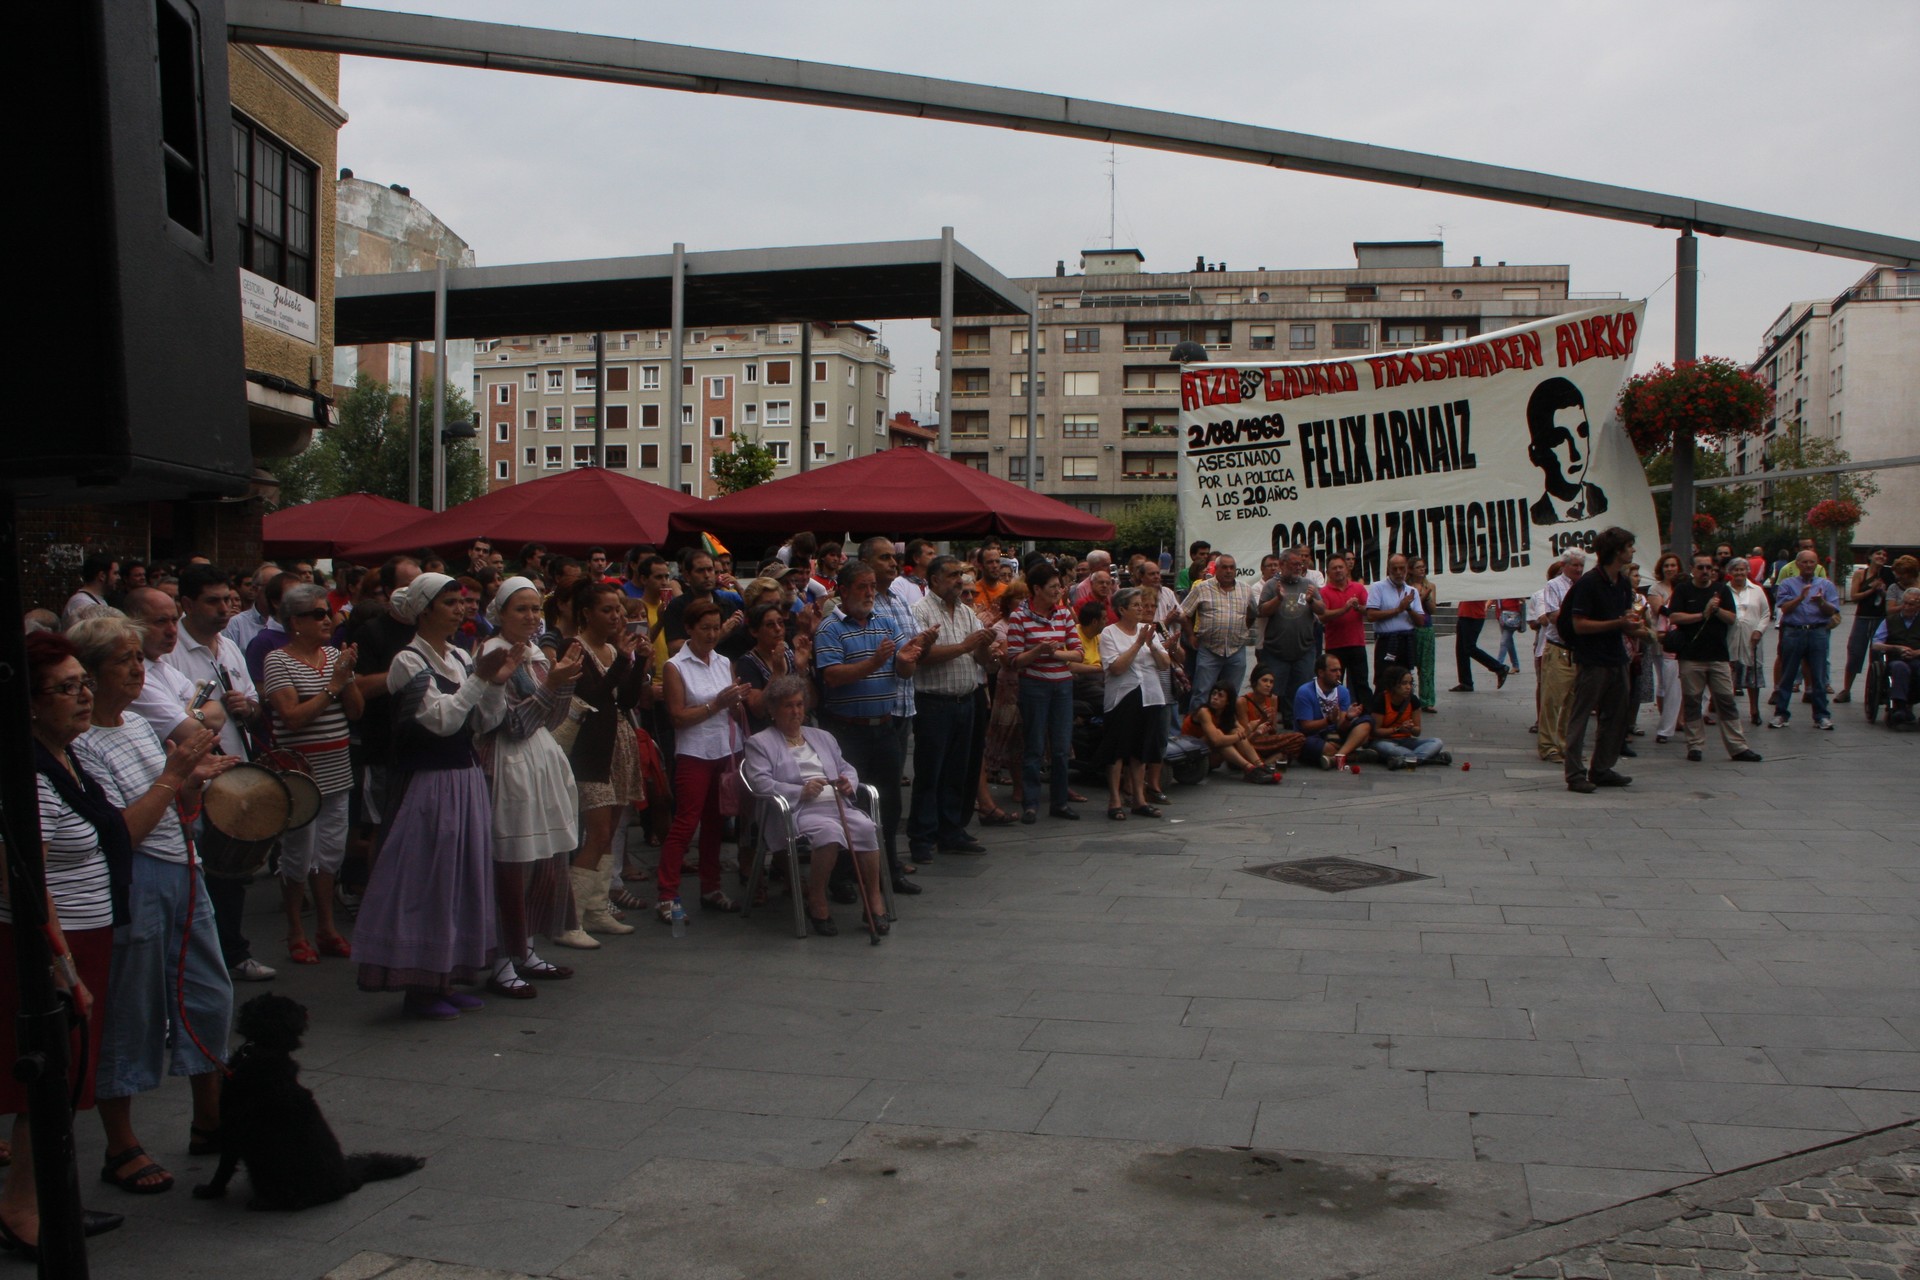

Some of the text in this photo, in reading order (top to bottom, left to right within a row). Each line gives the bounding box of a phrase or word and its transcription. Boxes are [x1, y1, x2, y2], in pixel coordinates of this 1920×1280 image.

[273, 286, 302, 313] Zubieta
[1181, 367, 1241, 411] ATZO
[1239, 369, 1265, 399] eta
[1260, 360, 1359, 402] GAURKO
[1365, 331, 1544, 390] FAXISMOAREN
[1187, 413, 1285, 449] 2/08/1969
[1298, 399, 1477, 488] FELIX ARNAIZ
[1196, 448, 1281, 473] ASESINADO
[1198, 468, 1295, 489] POR LA POLICIA
[1201, 485, 1299, 508] A LOS 20 AÑOS
[1216, 505, 1272, 522] DE EDAD.
[1549, 529, 1600, 558] 1969
[1234, 567, 1256, 577] AKO
